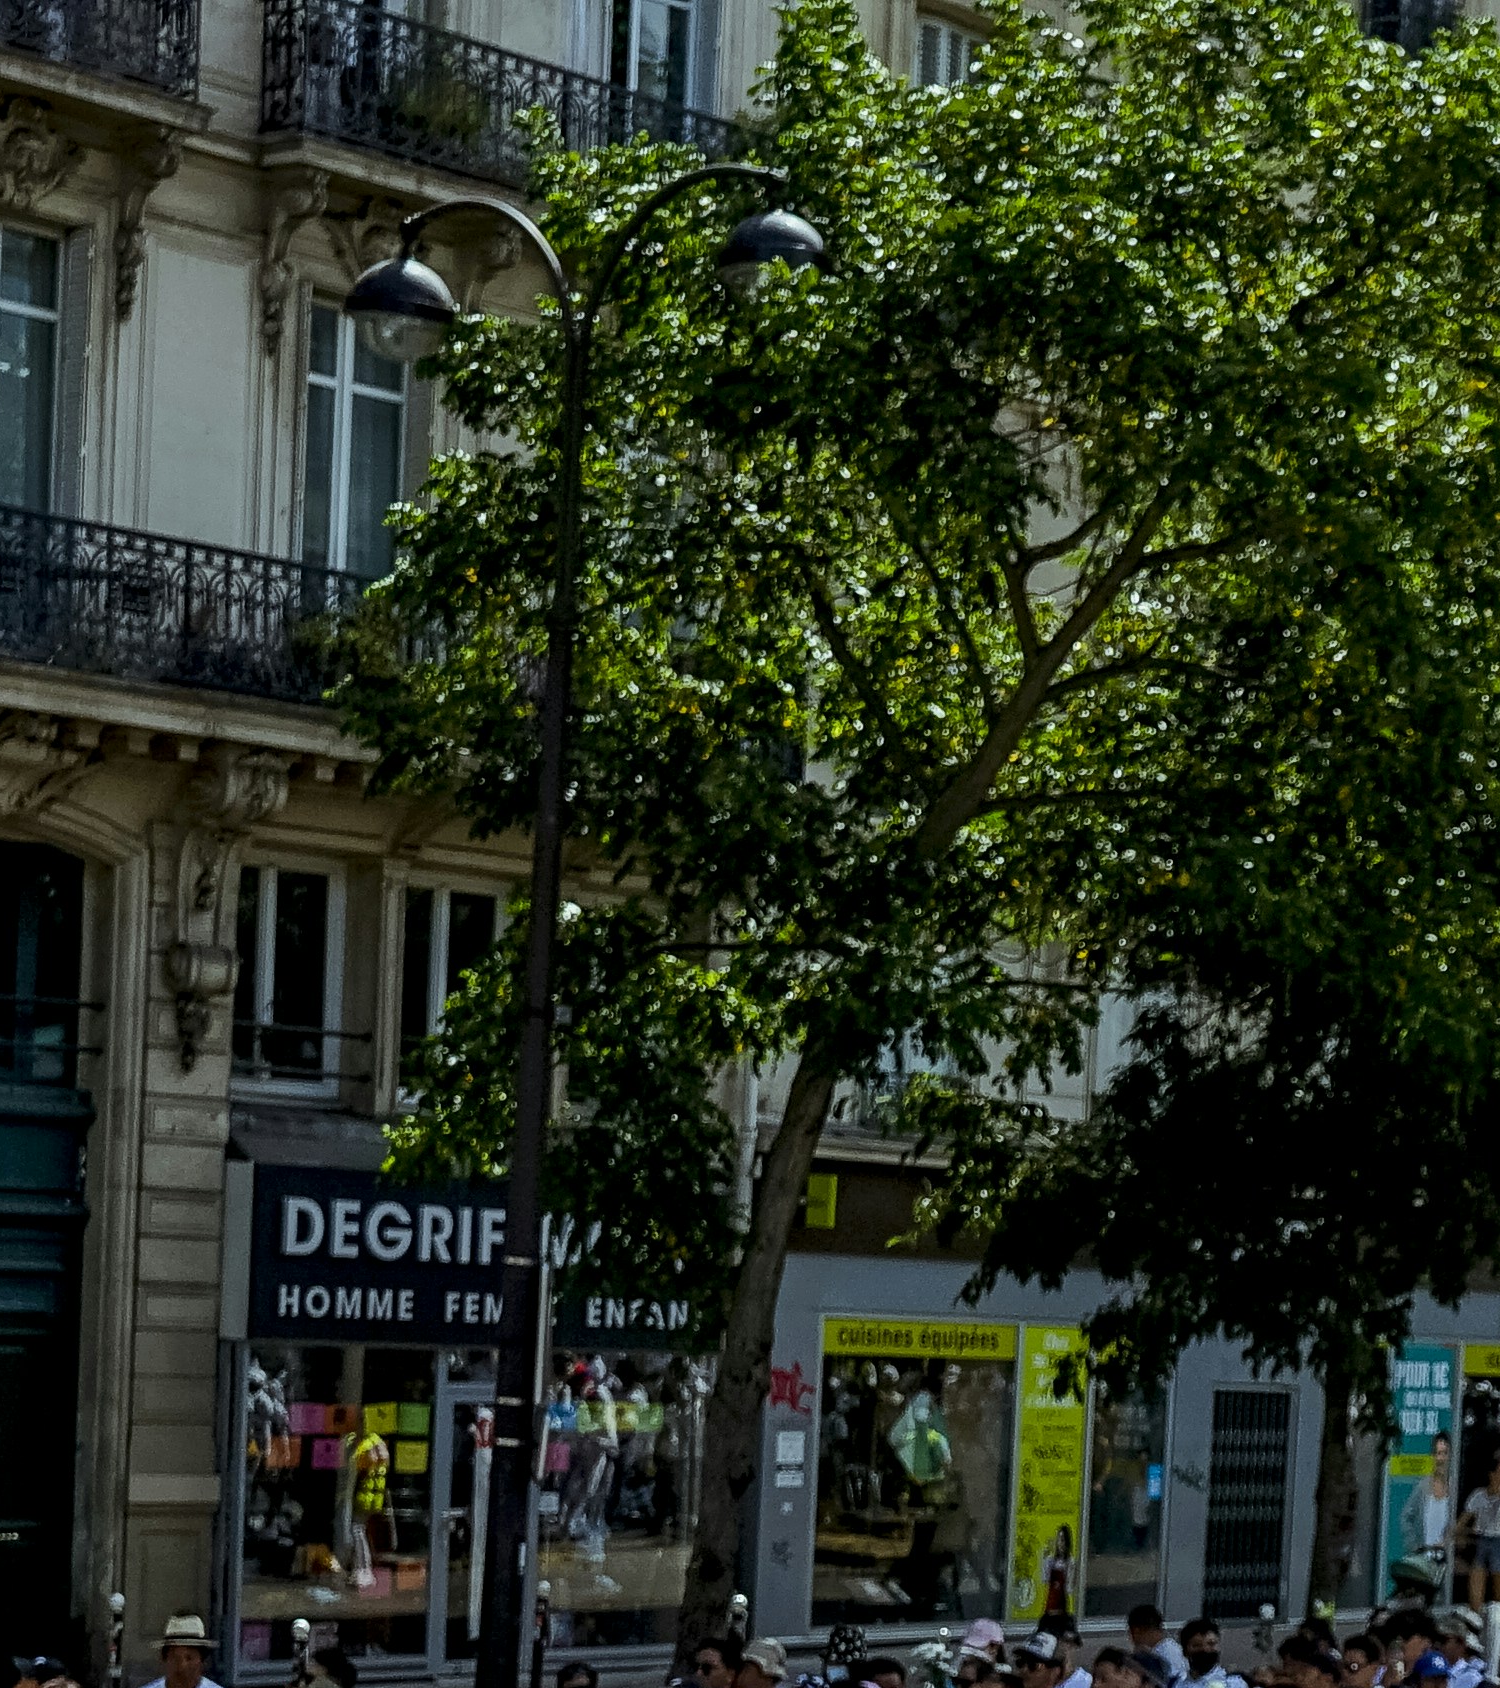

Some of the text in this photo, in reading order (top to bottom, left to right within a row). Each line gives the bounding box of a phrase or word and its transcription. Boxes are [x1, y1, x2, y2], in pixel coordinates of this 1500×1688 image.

[277, 1284, 415, 1321] HOMME
[586, 1296, 690, 1331] ENFAN
[837, 1325, 1000, 1355] cuisines équipées
